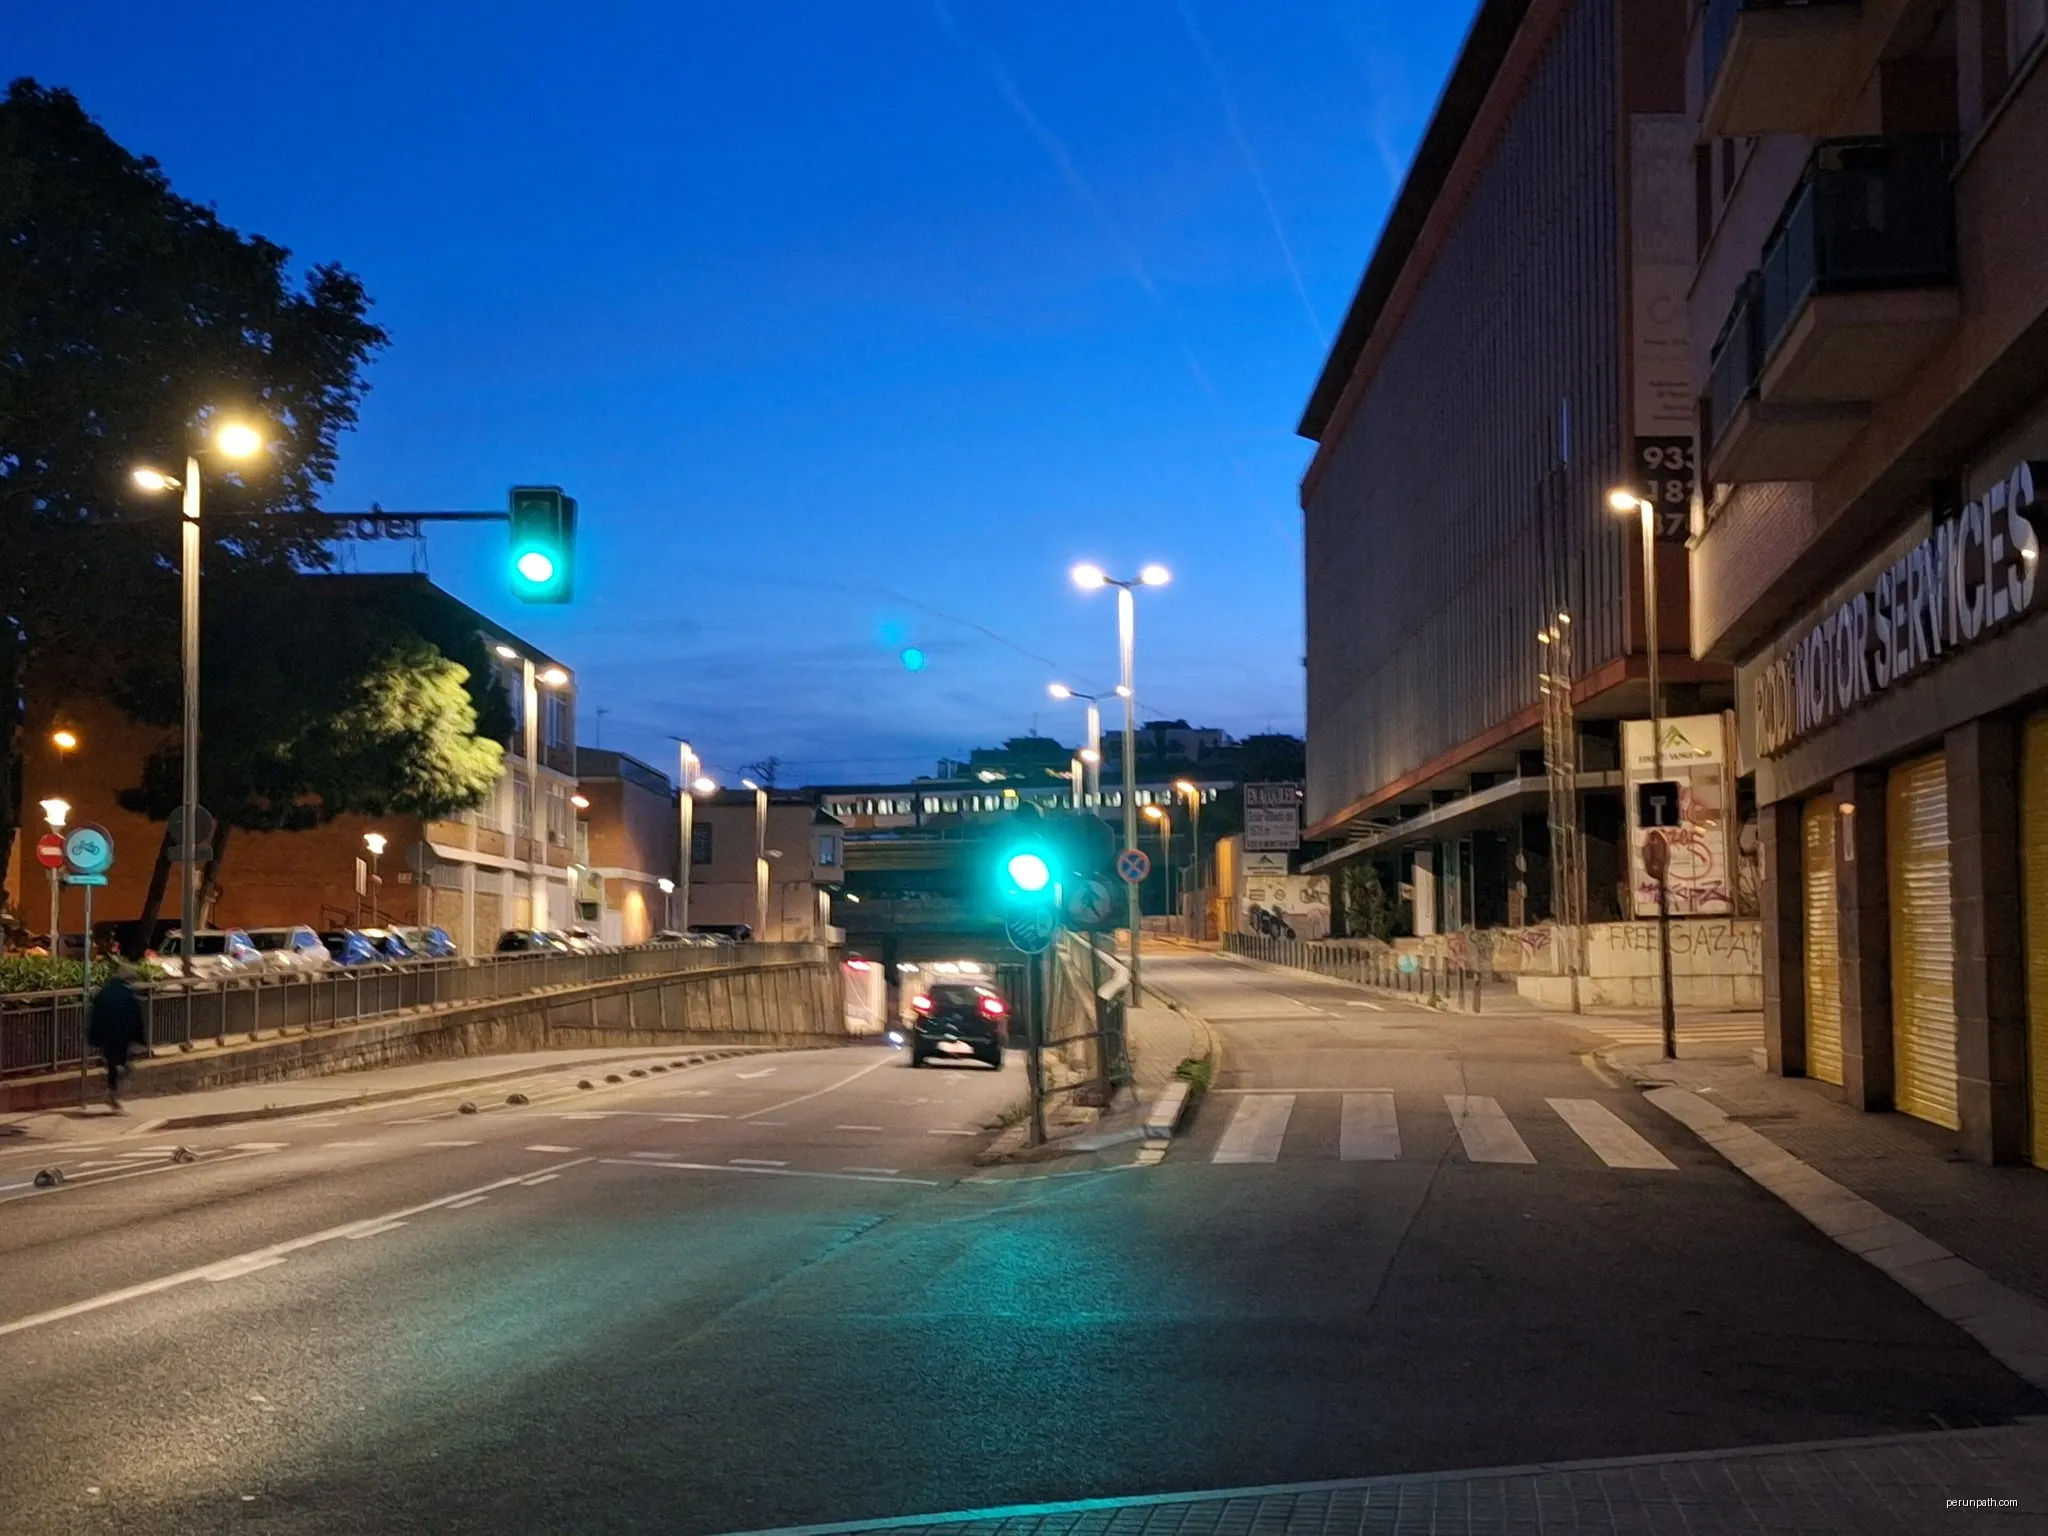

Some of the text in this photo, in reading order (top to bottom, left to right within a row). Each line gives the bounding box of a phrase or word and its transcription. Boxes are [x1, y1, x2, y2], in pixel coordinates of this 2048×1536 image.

[1794, 591, 1871, 733] MOTOR
[1875, 459, 2039, 690] SERVICES
[1608, 925, 1658, 952] FREE
